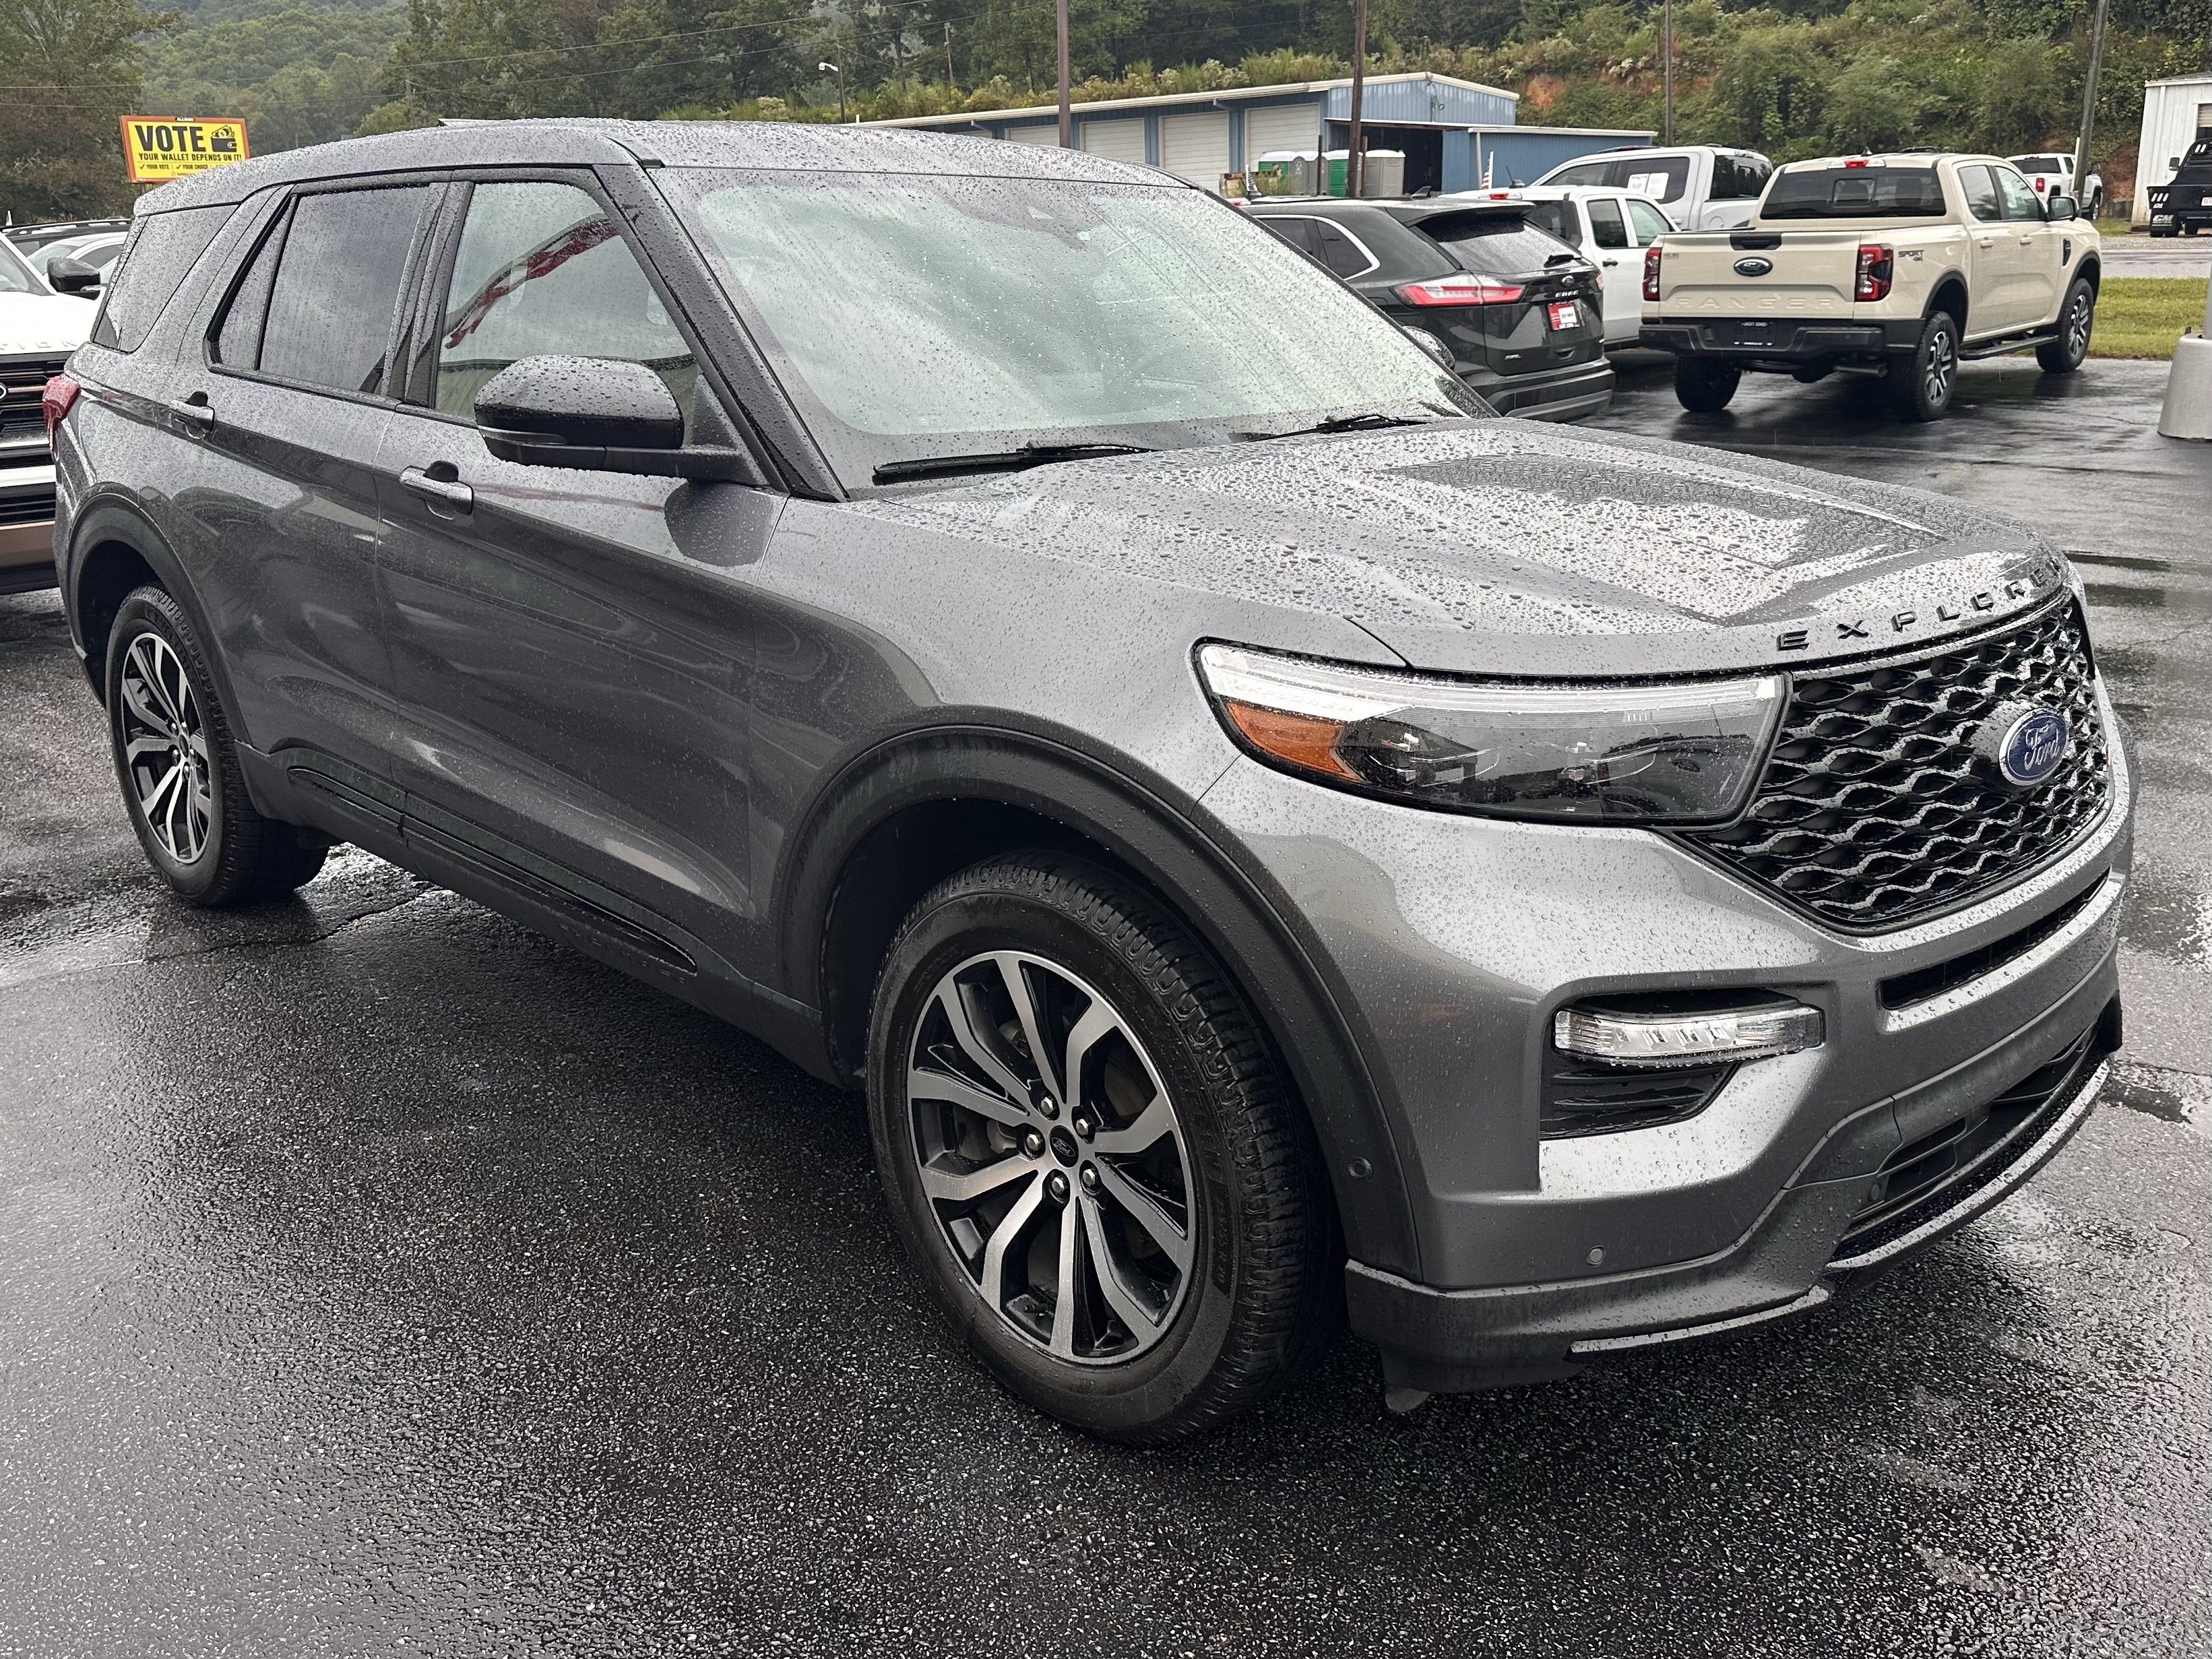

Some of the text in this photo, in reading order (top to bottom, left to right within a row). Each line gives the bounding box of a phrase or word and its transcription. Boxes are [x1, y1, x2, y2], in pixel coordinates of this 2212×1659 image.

[135, 125, 206, 152] VOTE
[138, 152, 159, 160] YOUR
[162, 153, 189, 161] WALLET
[234, 154, 242, 162] IT!
[1898, 249, 1924, 257] SPORT
[1674, 296, 1835, 310] RANGER
[1776, 555, 2063, 652] EXPLORER
[2023, 720, 2060, 772] Ford
[1054, 1139, 1071, 1155] Ford
